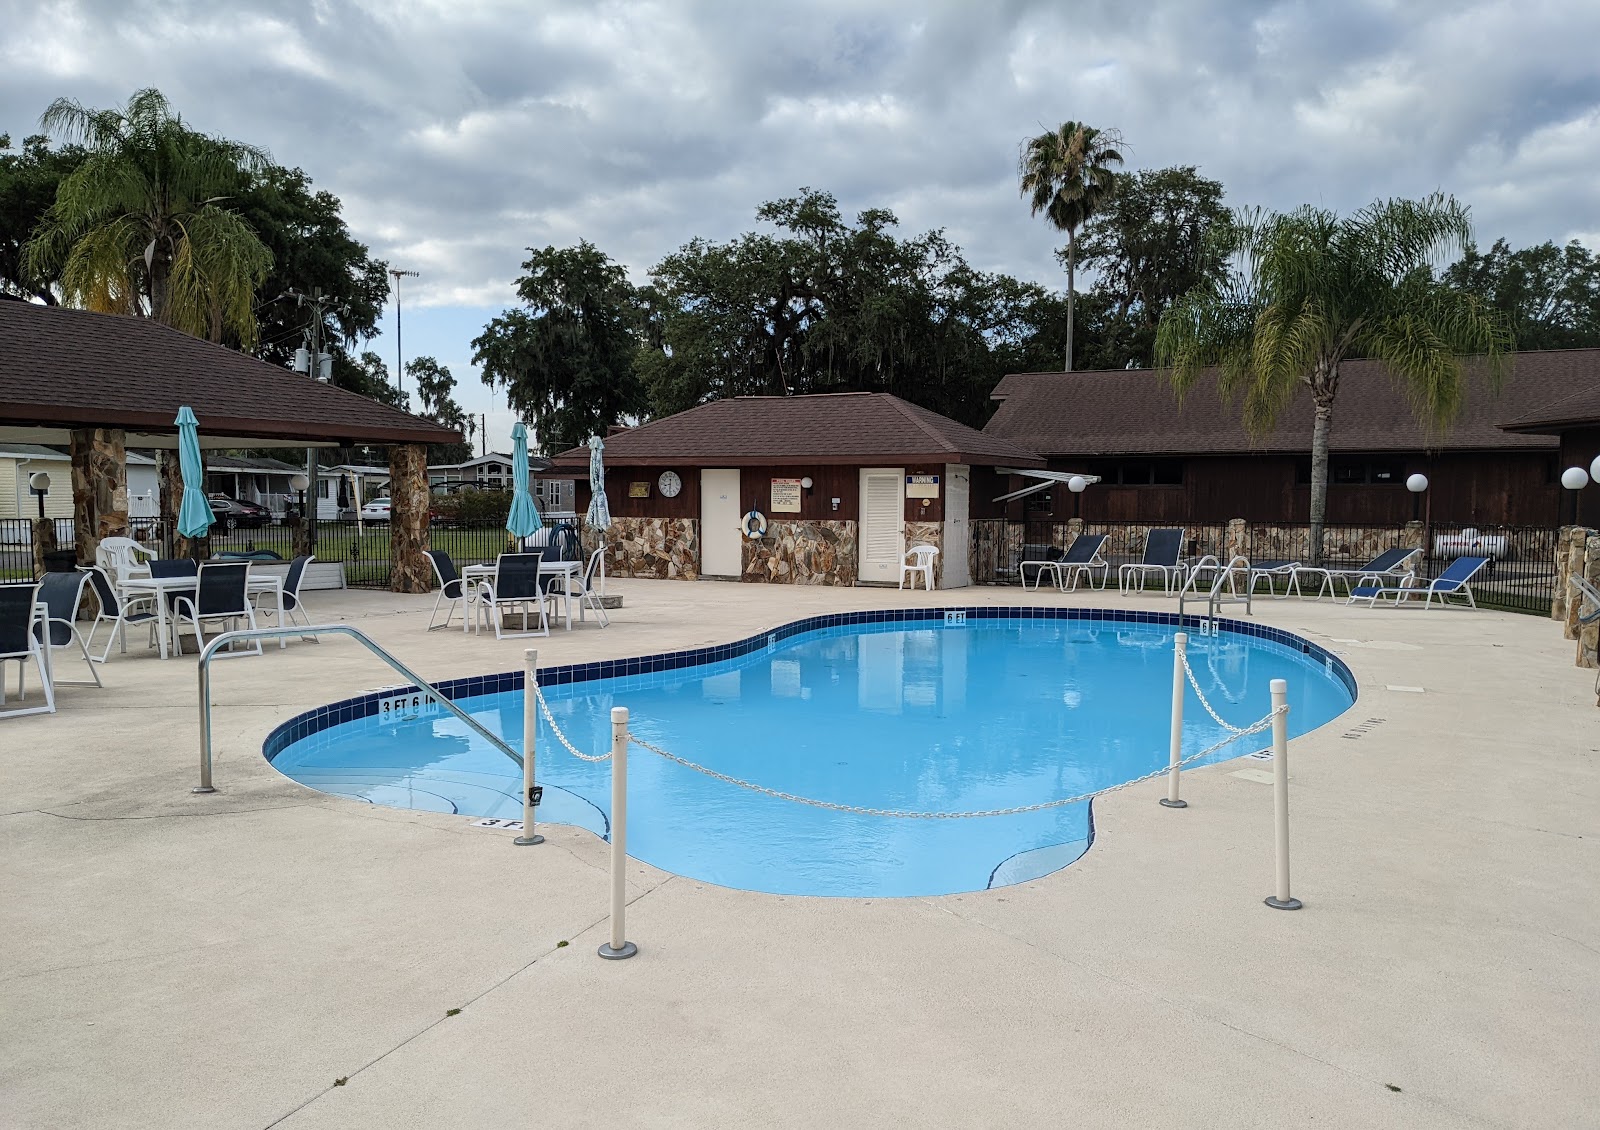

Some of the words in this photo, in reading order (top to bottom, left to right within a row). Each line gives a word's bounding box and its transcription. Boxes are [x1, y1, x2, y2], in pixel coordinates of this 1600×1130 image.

[383, 701, 390, 713] 3
[394, 699, 407, 709] FT
[412, 696, 419, 707] 6
